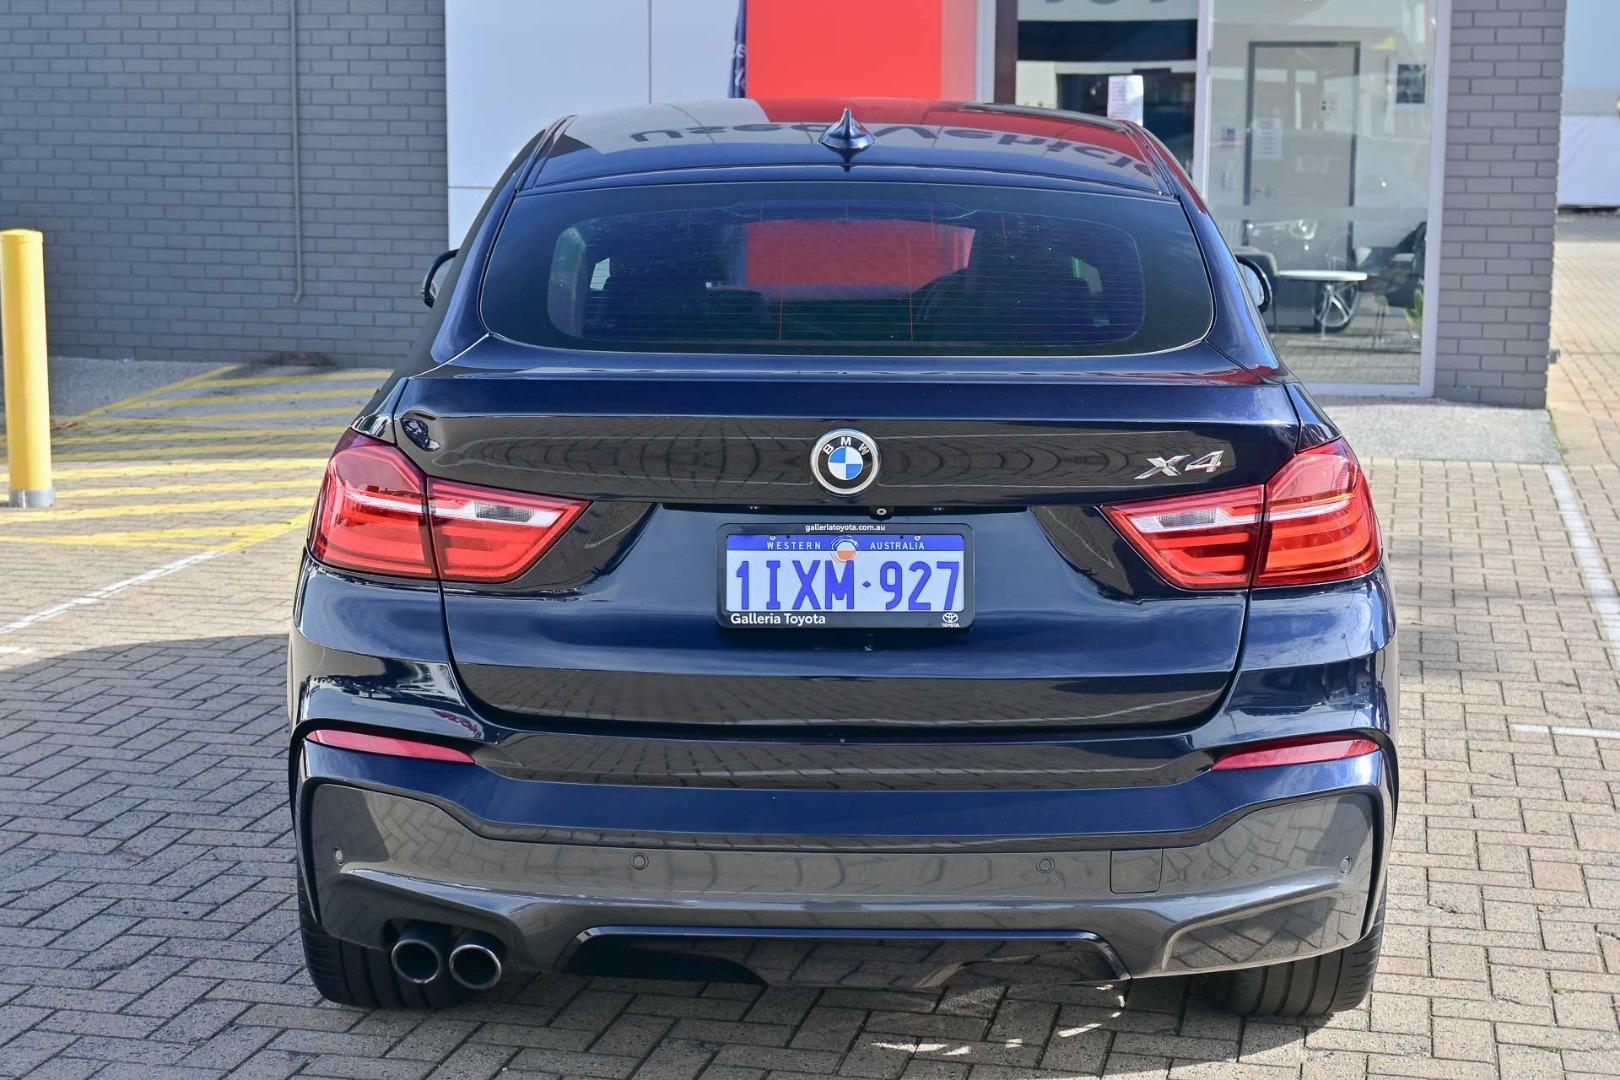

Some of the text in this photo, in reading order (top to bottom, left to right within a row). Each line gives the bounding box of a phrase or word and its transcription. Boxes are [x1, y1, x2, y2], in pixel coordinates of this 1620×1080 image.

[822, 436, 870, 456] BMW
[1133, 450, 1224, 480] X4
[805, 523, 886, 533] galleriatoyota.com.au
[767, 541, 925, 550] WESTERN AUSTRALIA
[730, 612, 826, 627] Galleria Toyota
